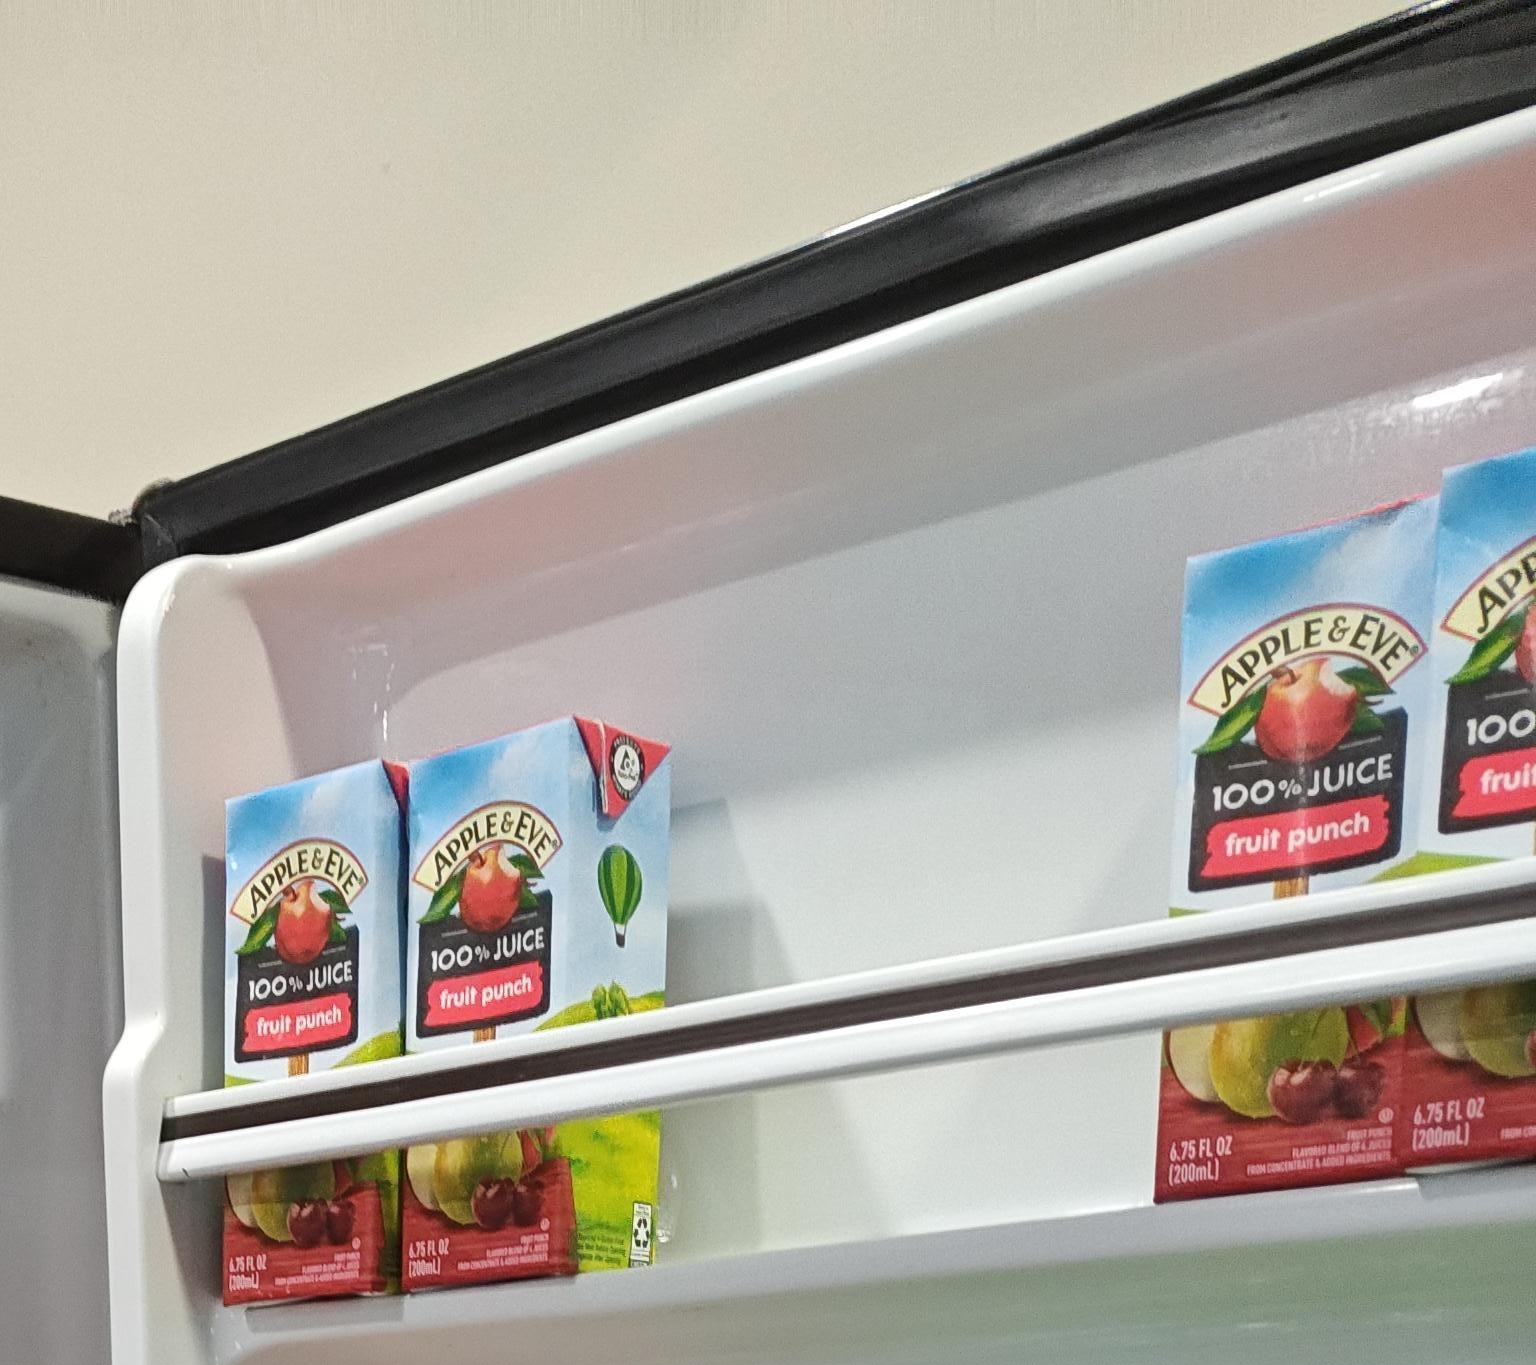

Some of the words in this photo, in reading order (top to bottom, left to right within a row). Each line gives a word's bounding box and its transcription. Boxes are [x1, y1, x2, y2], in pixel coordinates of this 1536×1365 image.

[1220, 617, 1323, 708] APPLE
[1329, 616, 1350, 642] &
[1212, 778, 1302, 811] 100%
[1308, 754, 1392, 797] JUICE
[433, 812, 496, 886] APPLE
[499, 809, 515, 834] &
[1225, 828, 1280, 857] fruit
[1288, 812, 1370, 852] punch
[249, 848, 313, 918] APPLE
[312, 851, 325, 868] &
[430, 944, 490, 971] 100%
[493, 928, 545, 961] JUICE
[248, 973, 302, 1001] 100%
[306, 961, 353, 989] JUICE
[439, 985, 478, 1009] fruit
[481, 975, 532, 1004] punch
[256, 1013, 292, 1037] fruit
[295, 1005, 342, 1034] punch
[1414, 1102, 1444, 1125] 6.75
[1447, 1099, 1462, 1121] FL
[1467, 1098, 1485, 1119] OZ
[1169, 1140, 1195, 1162] 6.75
[1199, 1138, 1212, 1159] FL
[1216, 1136, 1233, 1157] OZ
[1413, 1121, 1469, 1151] (200mL)
[1168, 1160, 1220, 1186] (200mL)
[408, 1242, 426, 1259] 6.75
[427, 1241, 437, 1256] FL
[438, 1238, 449, 1255] OZ
